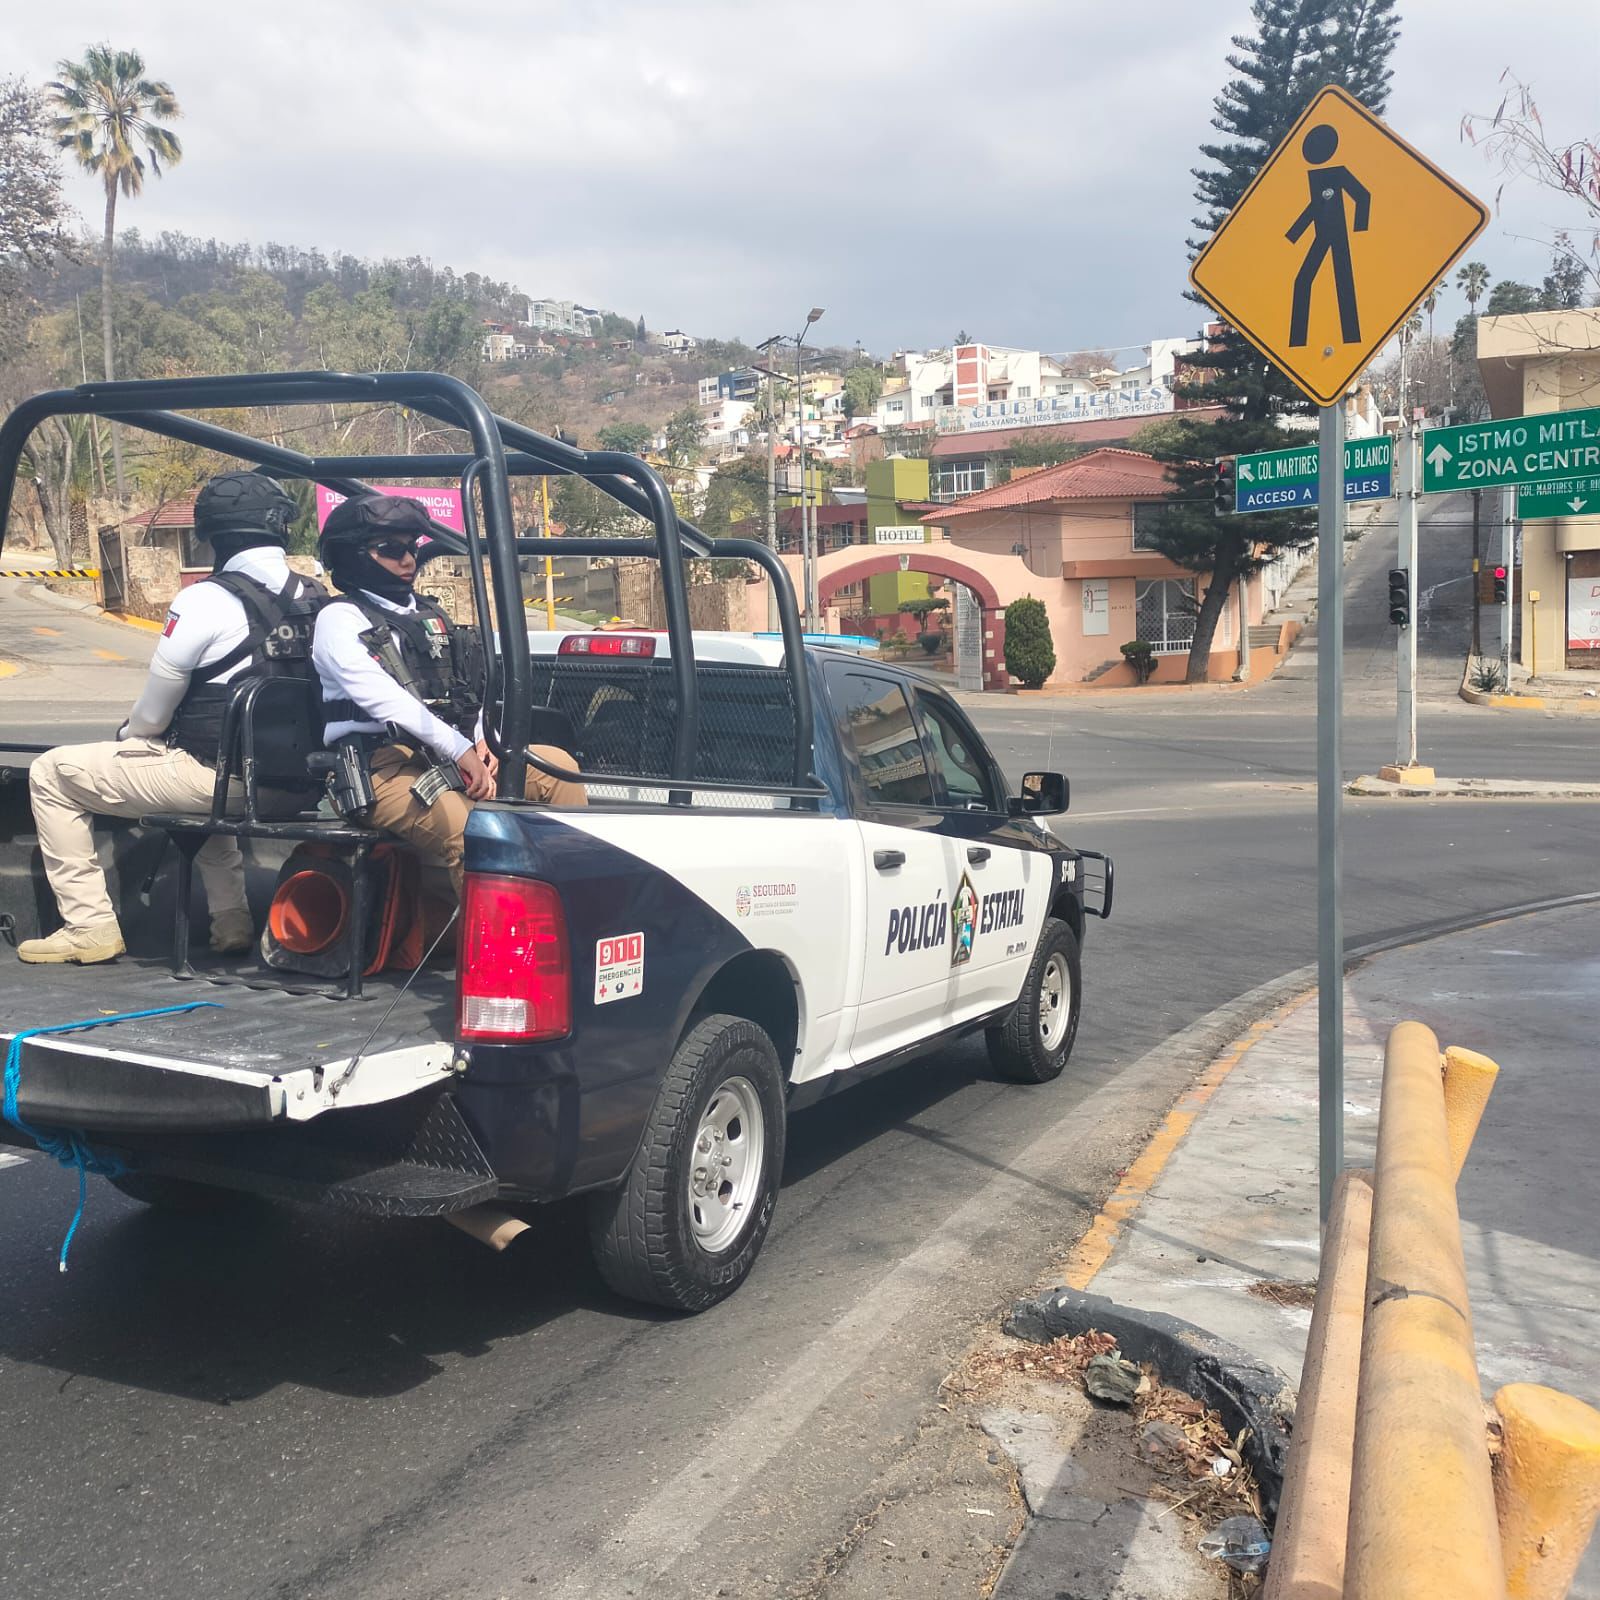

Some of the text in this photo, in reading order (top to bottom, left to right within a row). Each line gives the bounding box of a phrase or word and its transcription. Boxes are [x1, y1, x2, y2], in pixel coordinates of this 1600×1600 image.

[972, 401, 1027, 419] CLUB
[1037, 397, 1067, 412] DE
[1458, 419, 1600, 454] ISTMO MITL
[1257, 461, 1275, 481] COL.
[1276, 454, 1318, 478] MARTIRES
[1354, 445, 1390, 469] BLANCO
[1457, 456, 1518, 480] ZONA
[1247, 480, 1380, 506] ACCESO A ELES
[1536, 481, 1573, 496] MARTIRES
[1576, 479, 1586, 493] DE
[431, 508, 453, 518] TULE
[878, 529, 923, 541] HOTEL
[752, 883, 797, 898] SEGURIDAD
[884, 888, 1026, 956] POLICÍA ESTATAL
[602, 938, 639, 964] 911
[598, 966, 641, 983] EMERGENCIAS
